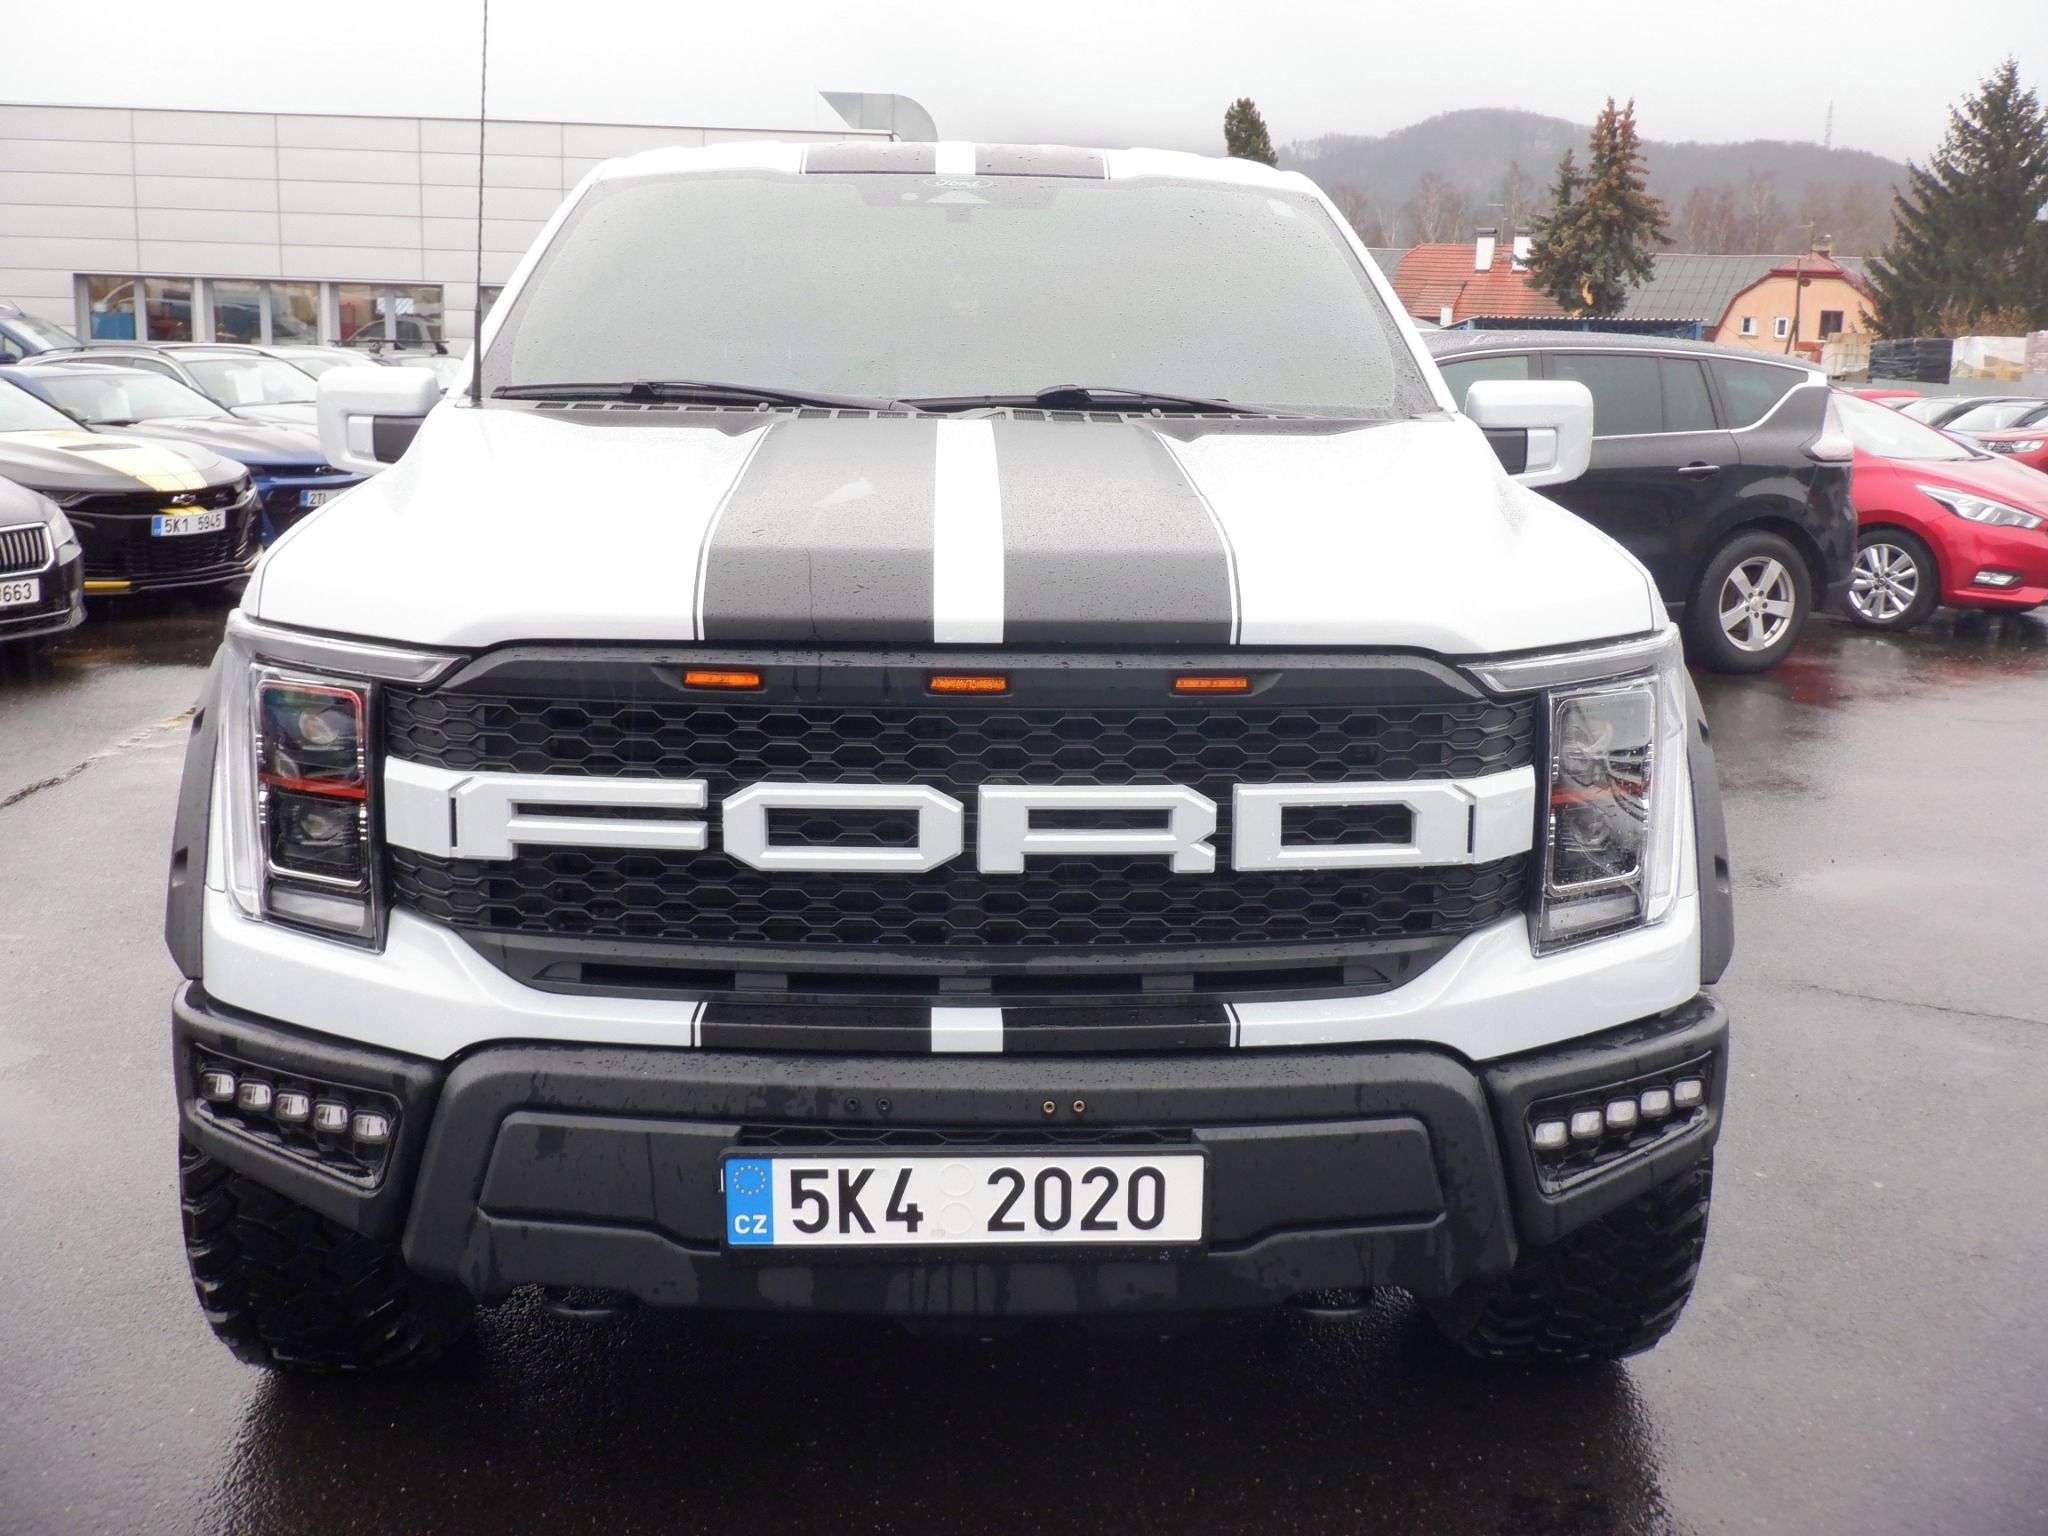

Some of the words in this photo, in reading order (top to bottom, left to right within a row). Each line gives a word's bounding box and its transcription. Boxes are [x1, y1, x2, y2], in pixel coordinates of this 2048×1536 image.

[165, 518, 188, 533] 5K1
[198, 513, 221, 530] 5945
[0, 583, 32, 602] 663
[456, 775, 1468, 872] FORD
[790, 1168, 924, 1233] 5K4
[987, 1166, 1166, 1231] 2020
[734, 1214, 767, 1234] CZ
